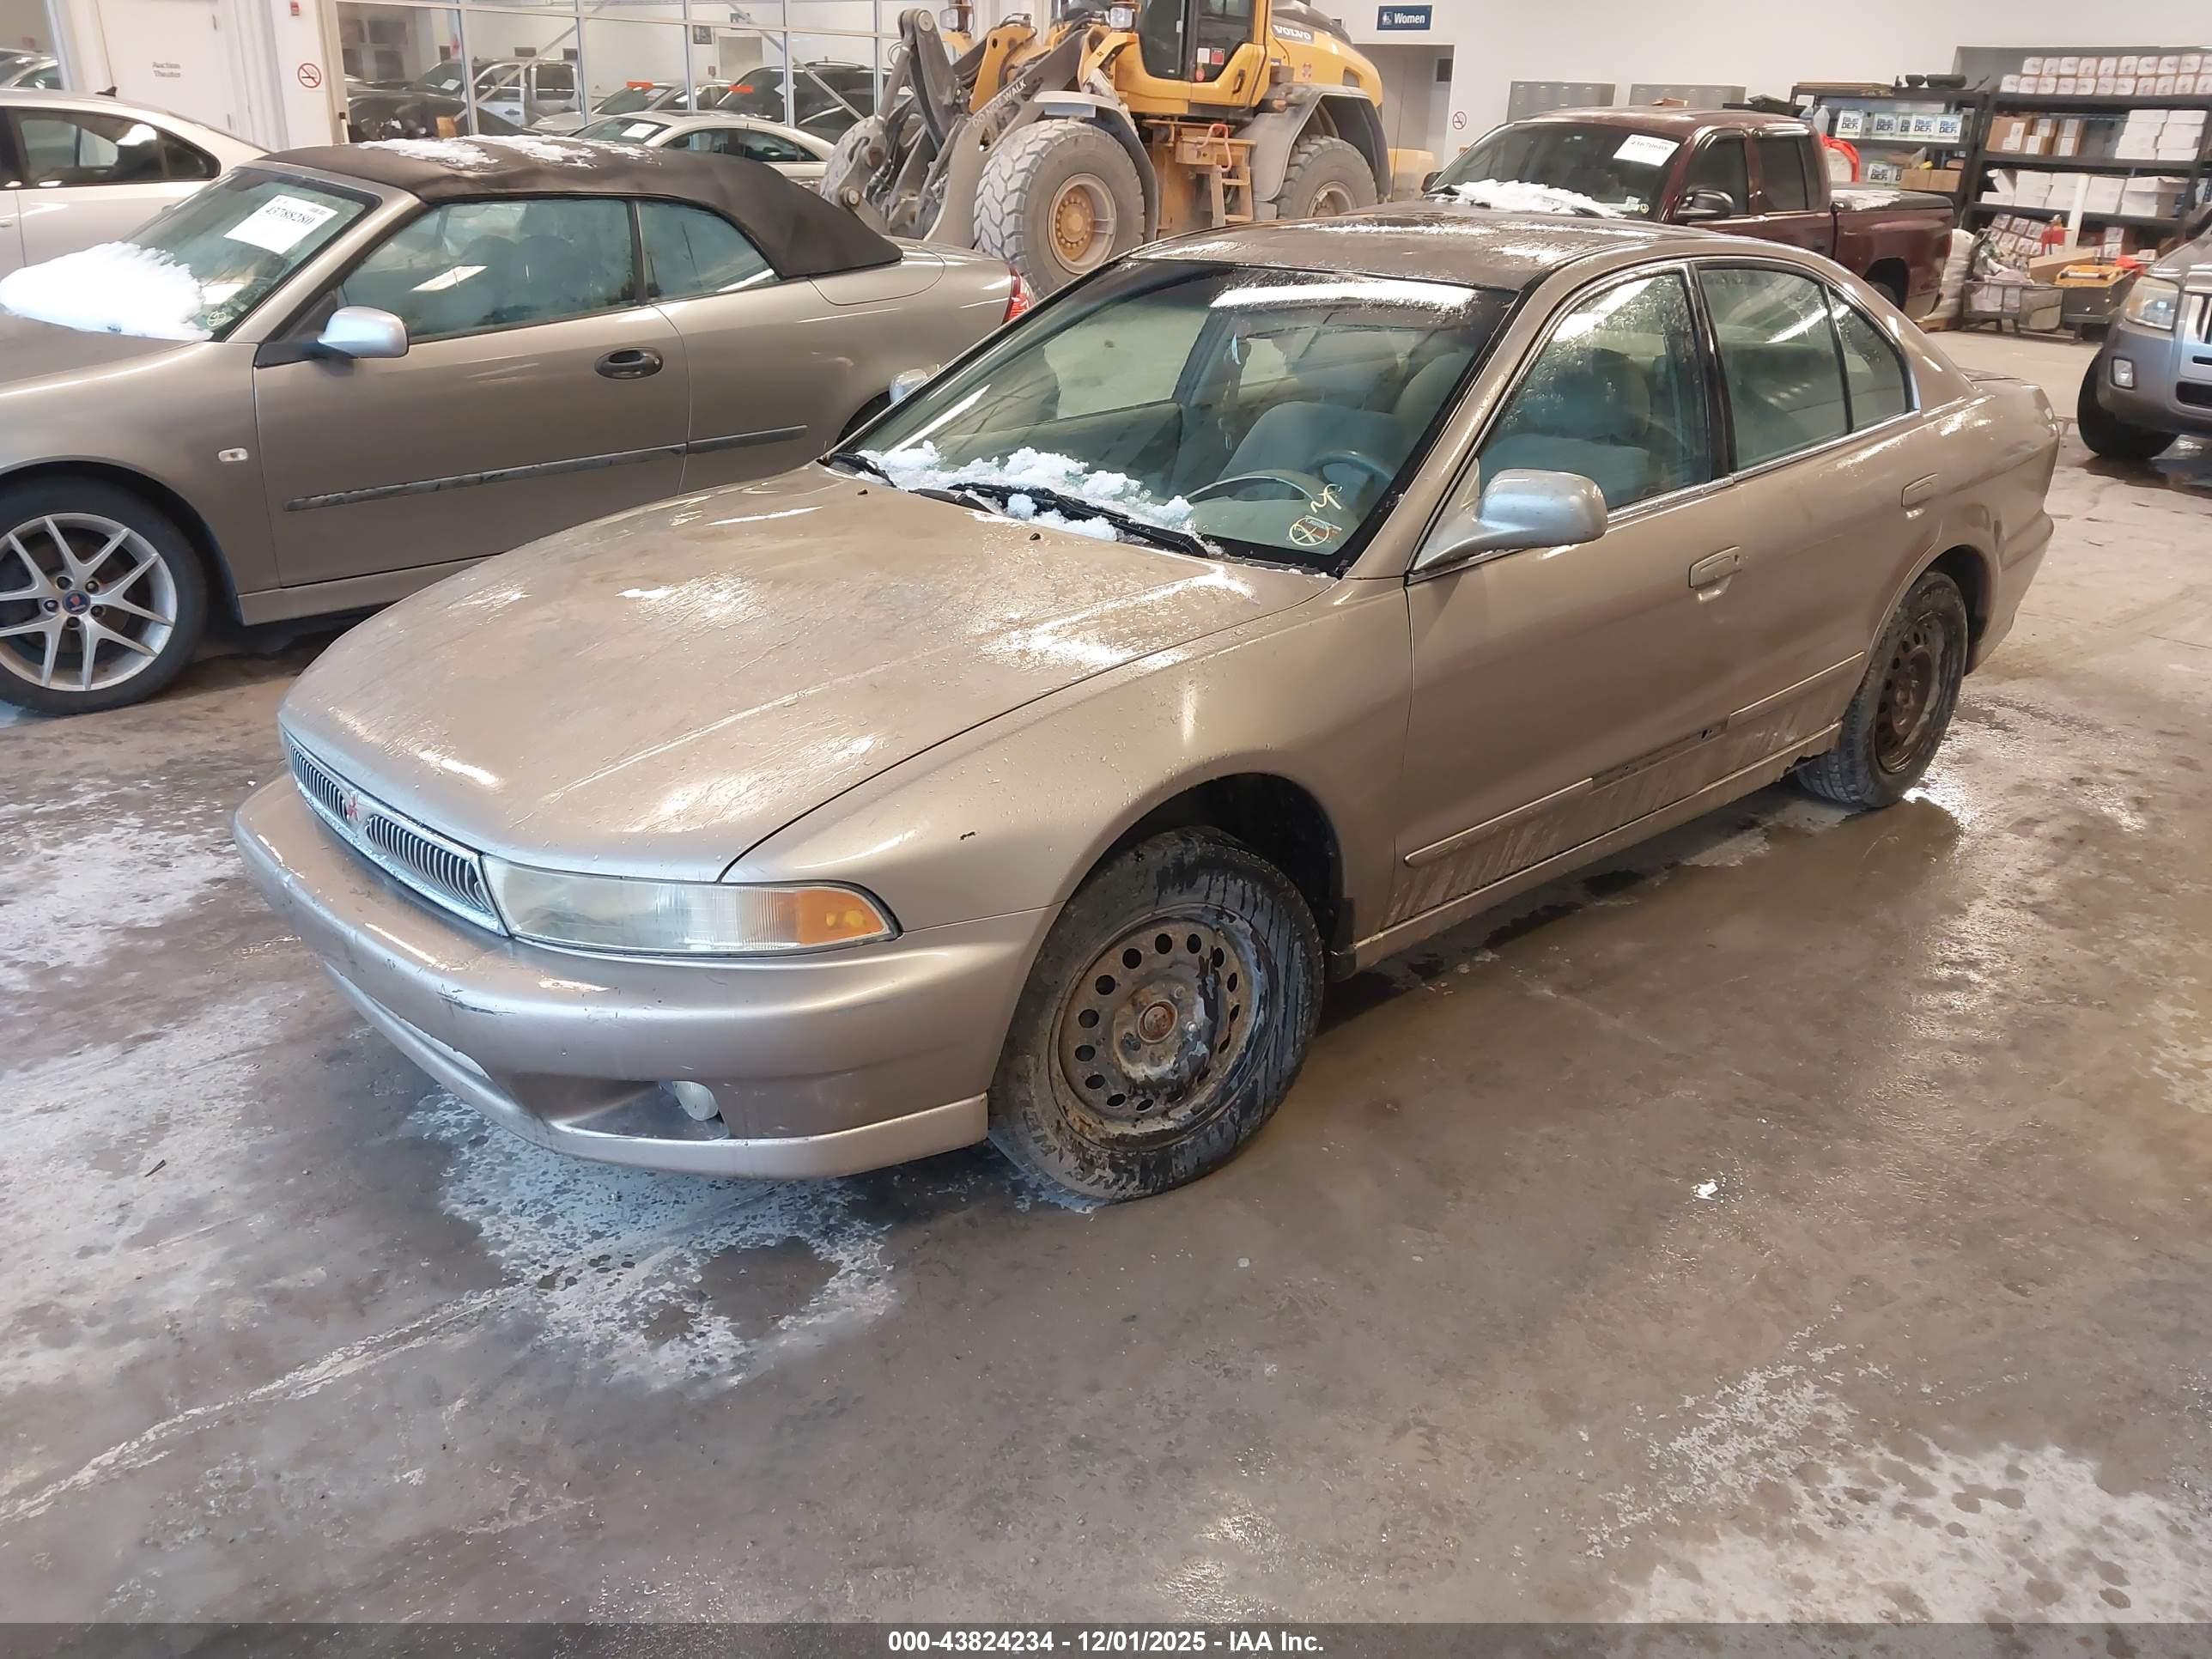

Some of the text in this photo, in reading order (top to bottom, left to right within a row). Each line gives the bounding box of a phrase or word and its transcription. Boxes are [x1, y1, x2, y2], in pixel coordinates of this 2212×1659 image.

[1394, 12, 1425, 24] Women
[1273, 25, 1312, 40] VOLVO
[1003, 78, 1027, 101] WALK
